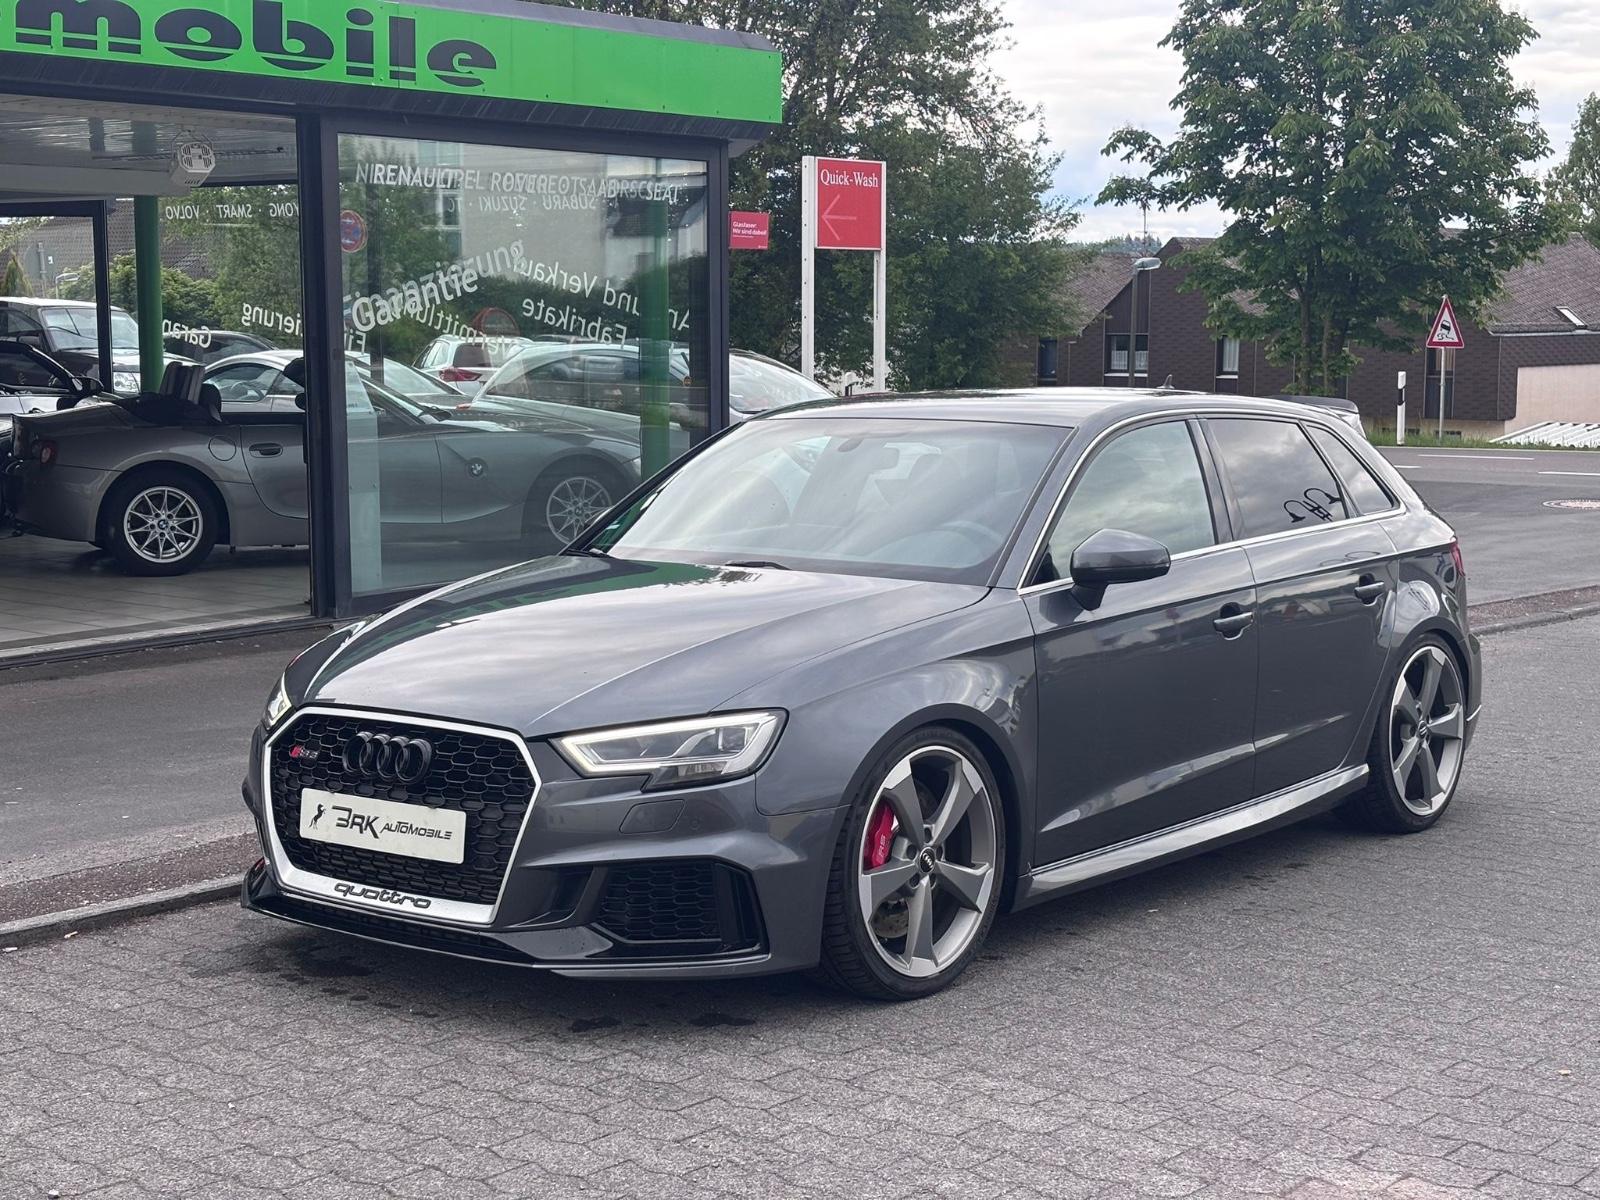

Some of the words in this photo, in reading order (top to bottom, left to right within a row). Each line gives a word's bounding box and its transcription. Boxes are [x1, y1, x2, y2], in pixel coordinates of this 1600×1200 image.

[15, 0, 498, 88] mobile
[373, 163, 452, 189] RENAULT
[820, 169, 879, 188] Quick-Wash
[351, 265, 479, 332] Garantie
[333, 882, 432, 909] quattro
